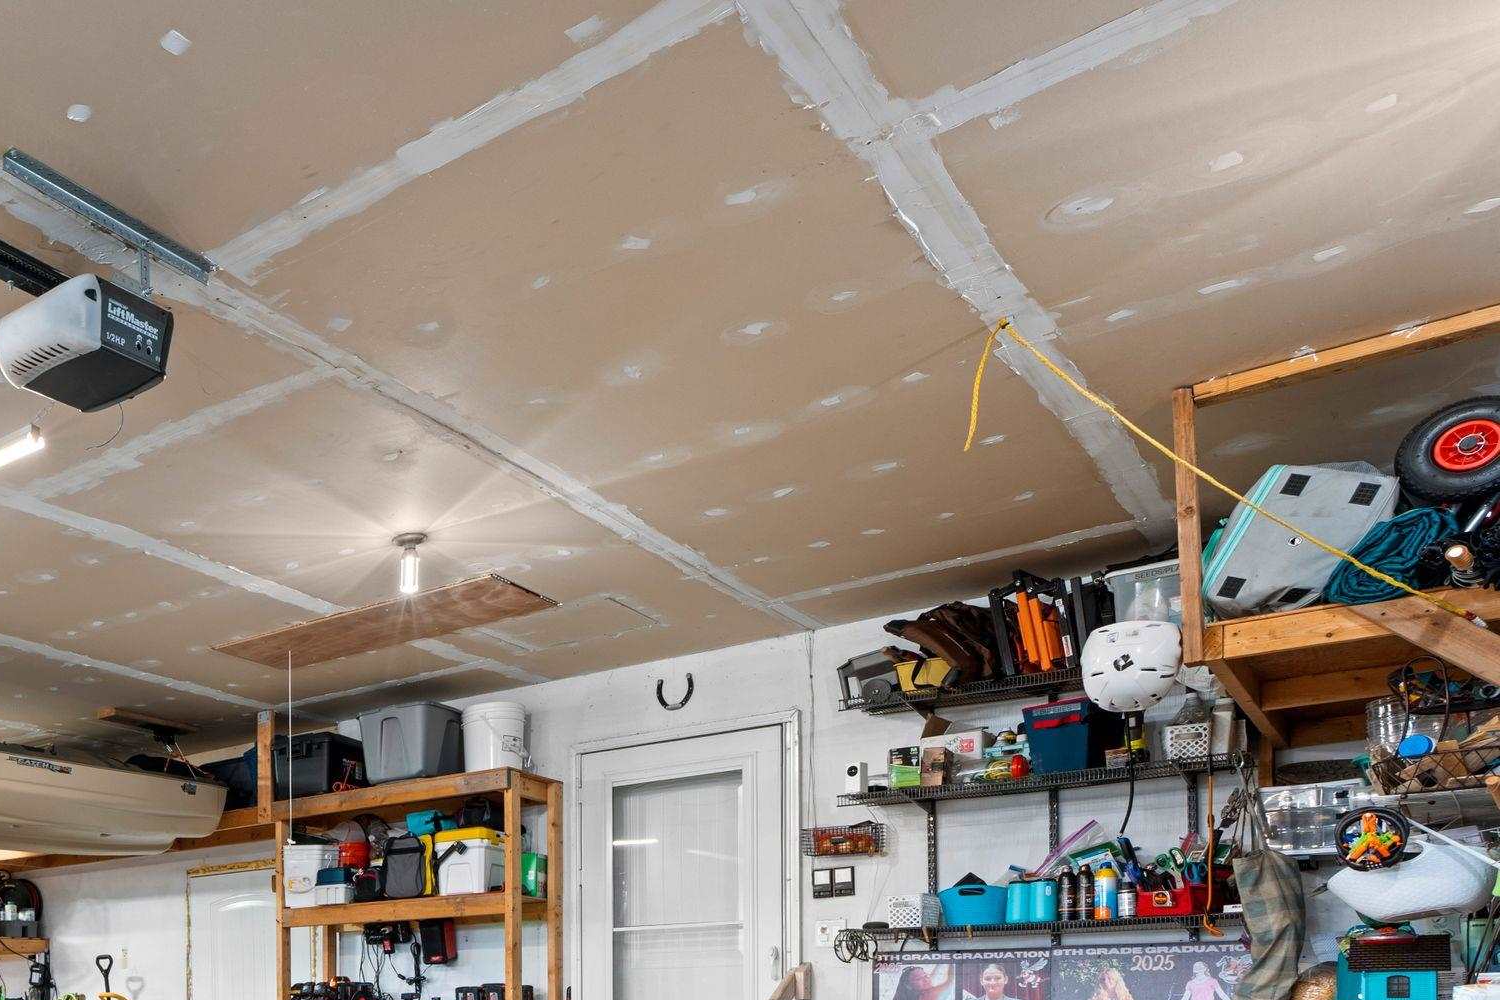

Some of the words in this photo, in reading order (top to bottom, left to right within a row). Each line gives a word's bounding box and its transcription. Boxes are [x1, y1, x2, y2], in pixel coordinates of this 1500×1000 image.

[108, 302, 159, 334] LiftMaster
[1134, 562, 1180, 580] SEEDS/PLA
[902, 953, 951, 961] GRADE
[953, 950, 1050, 960] GRADUATION
[1085, 946, 1143, 955] GRADE
[1144, 944, 1246, 954] GRADUATIO
[1130, 954, 1176, 972] 2025
